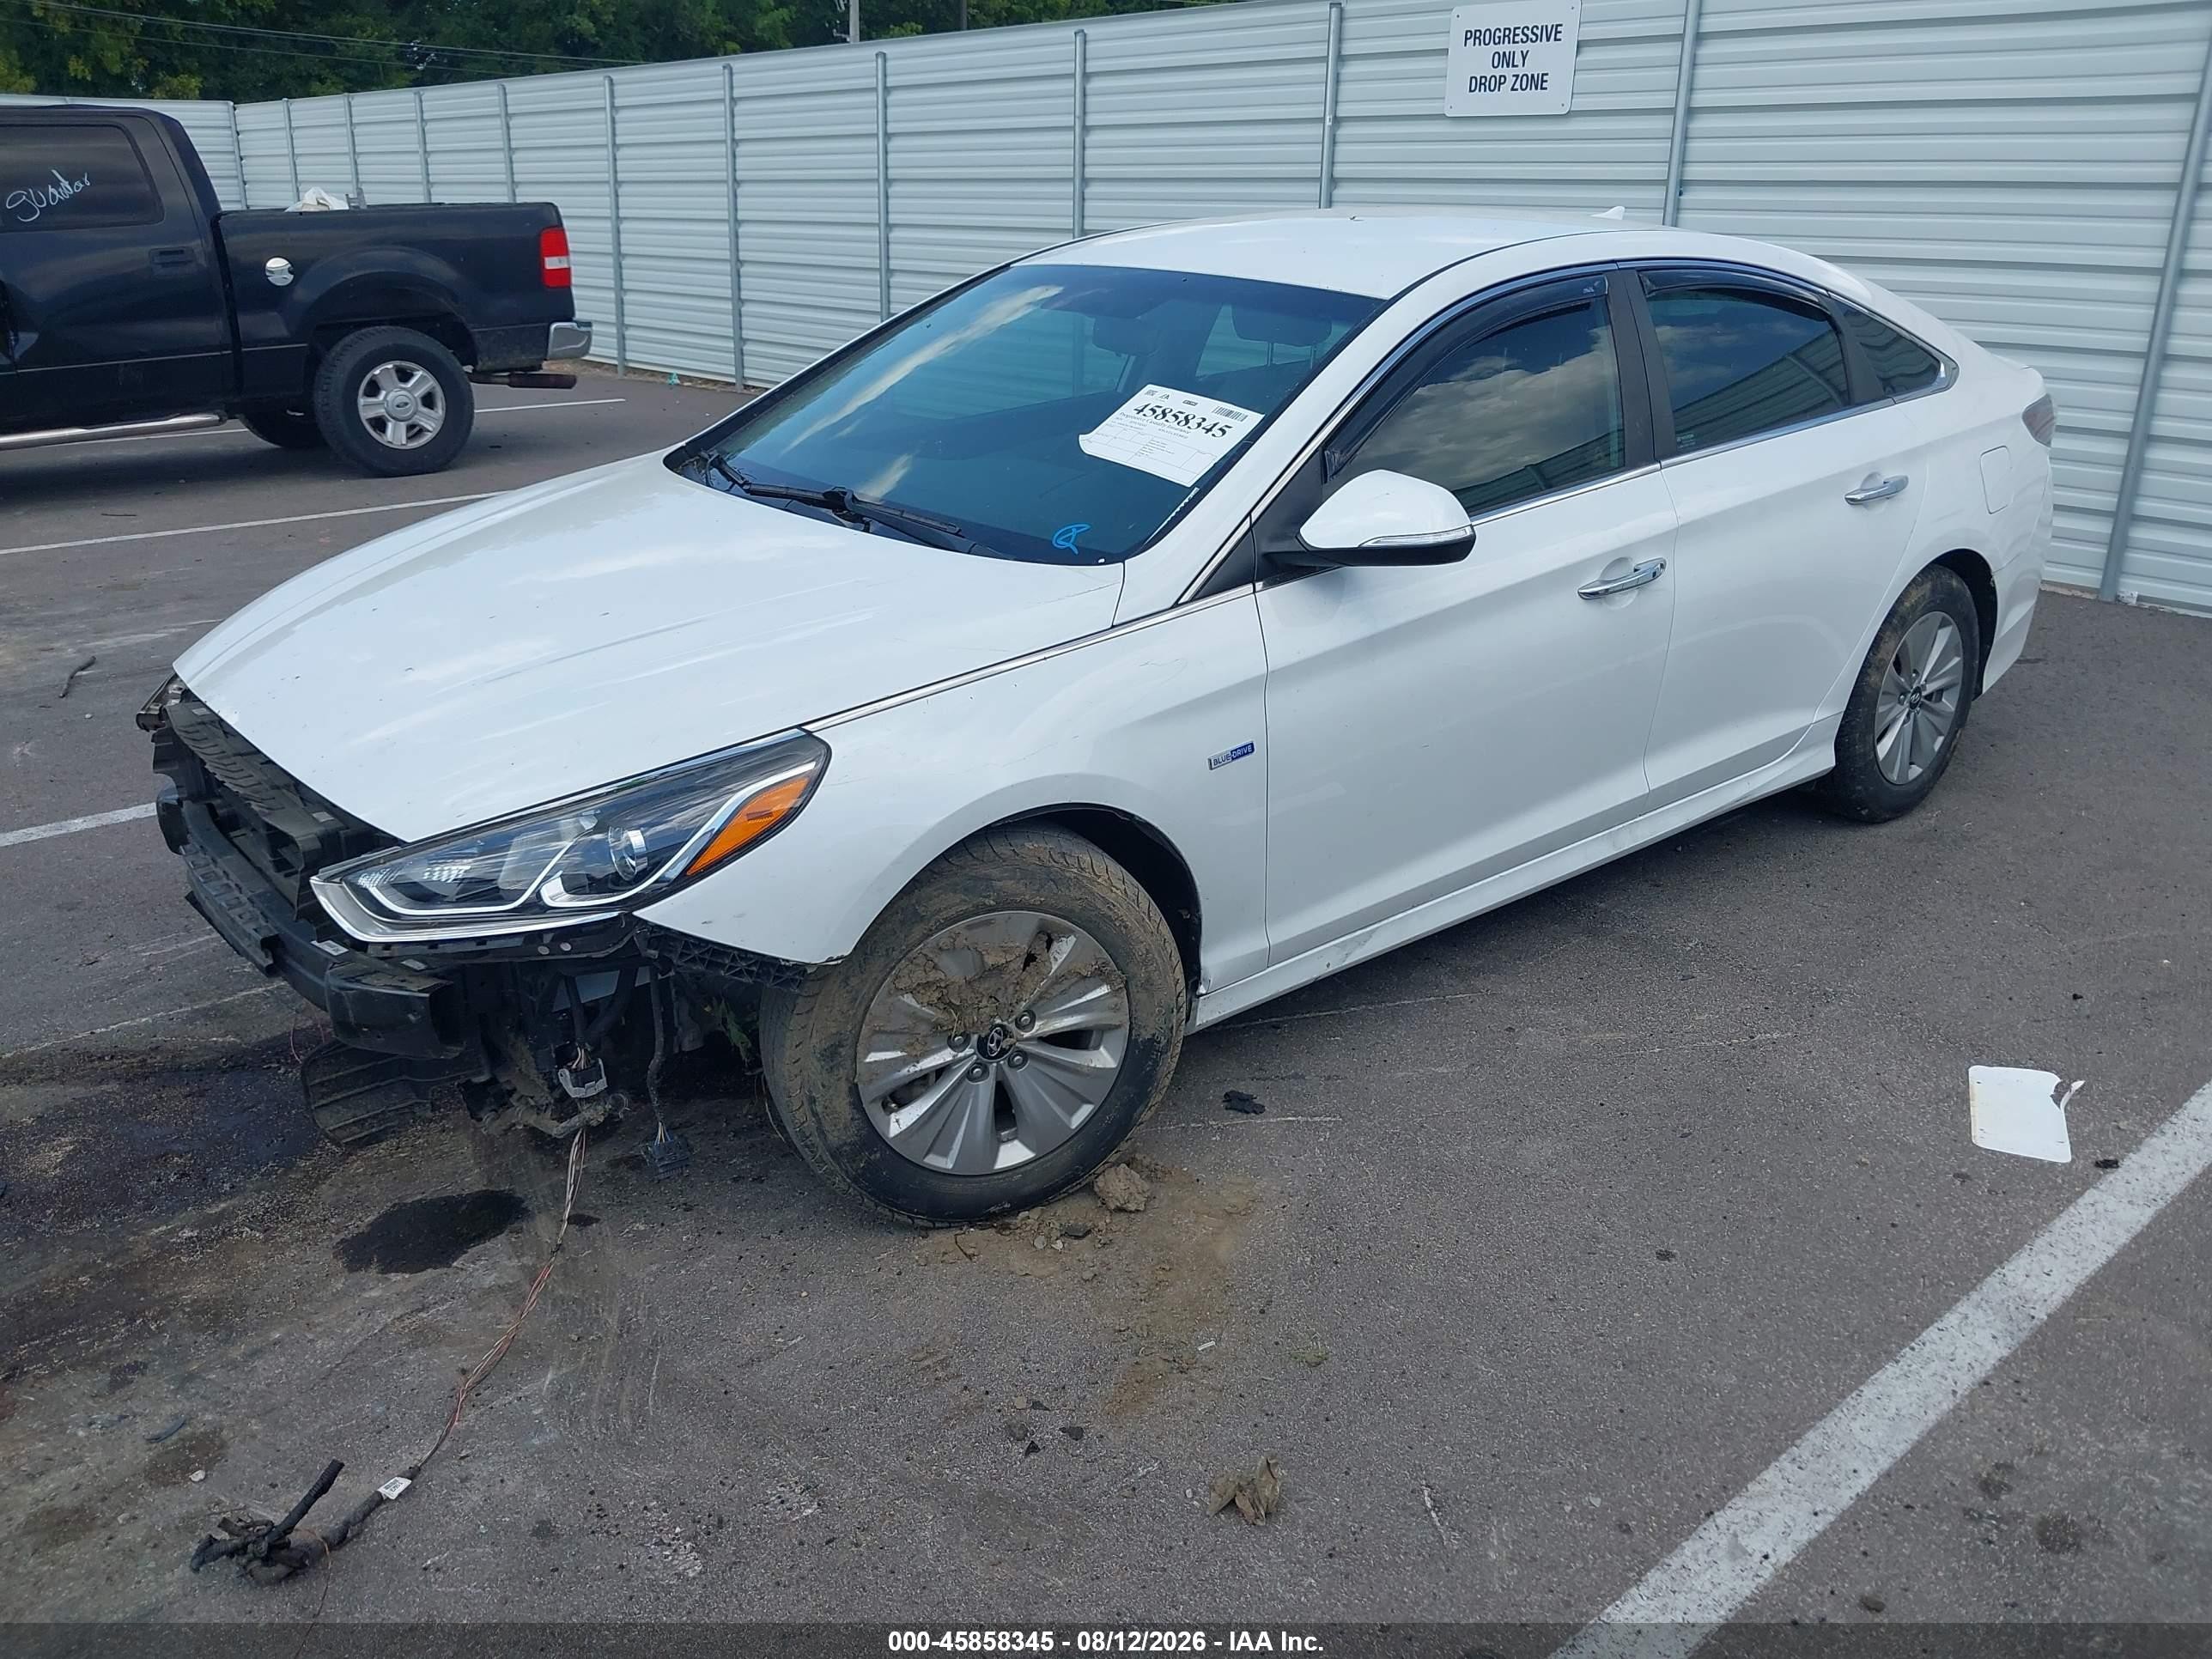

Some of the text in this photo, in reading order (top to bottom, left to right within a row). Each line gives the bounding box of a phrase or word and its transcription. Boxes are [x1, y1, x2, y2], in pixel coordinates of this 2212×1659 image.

[1464, 24, 1563, 46] PROGRESSIVE
[1491, 50, 1529, 69] ONLY
[1468, 73, 1548, 93] DROP ZONE
[1133, 402, 1233, 438] 45858345
[1213, 744, 1252, 766] BLUE DRIVE
